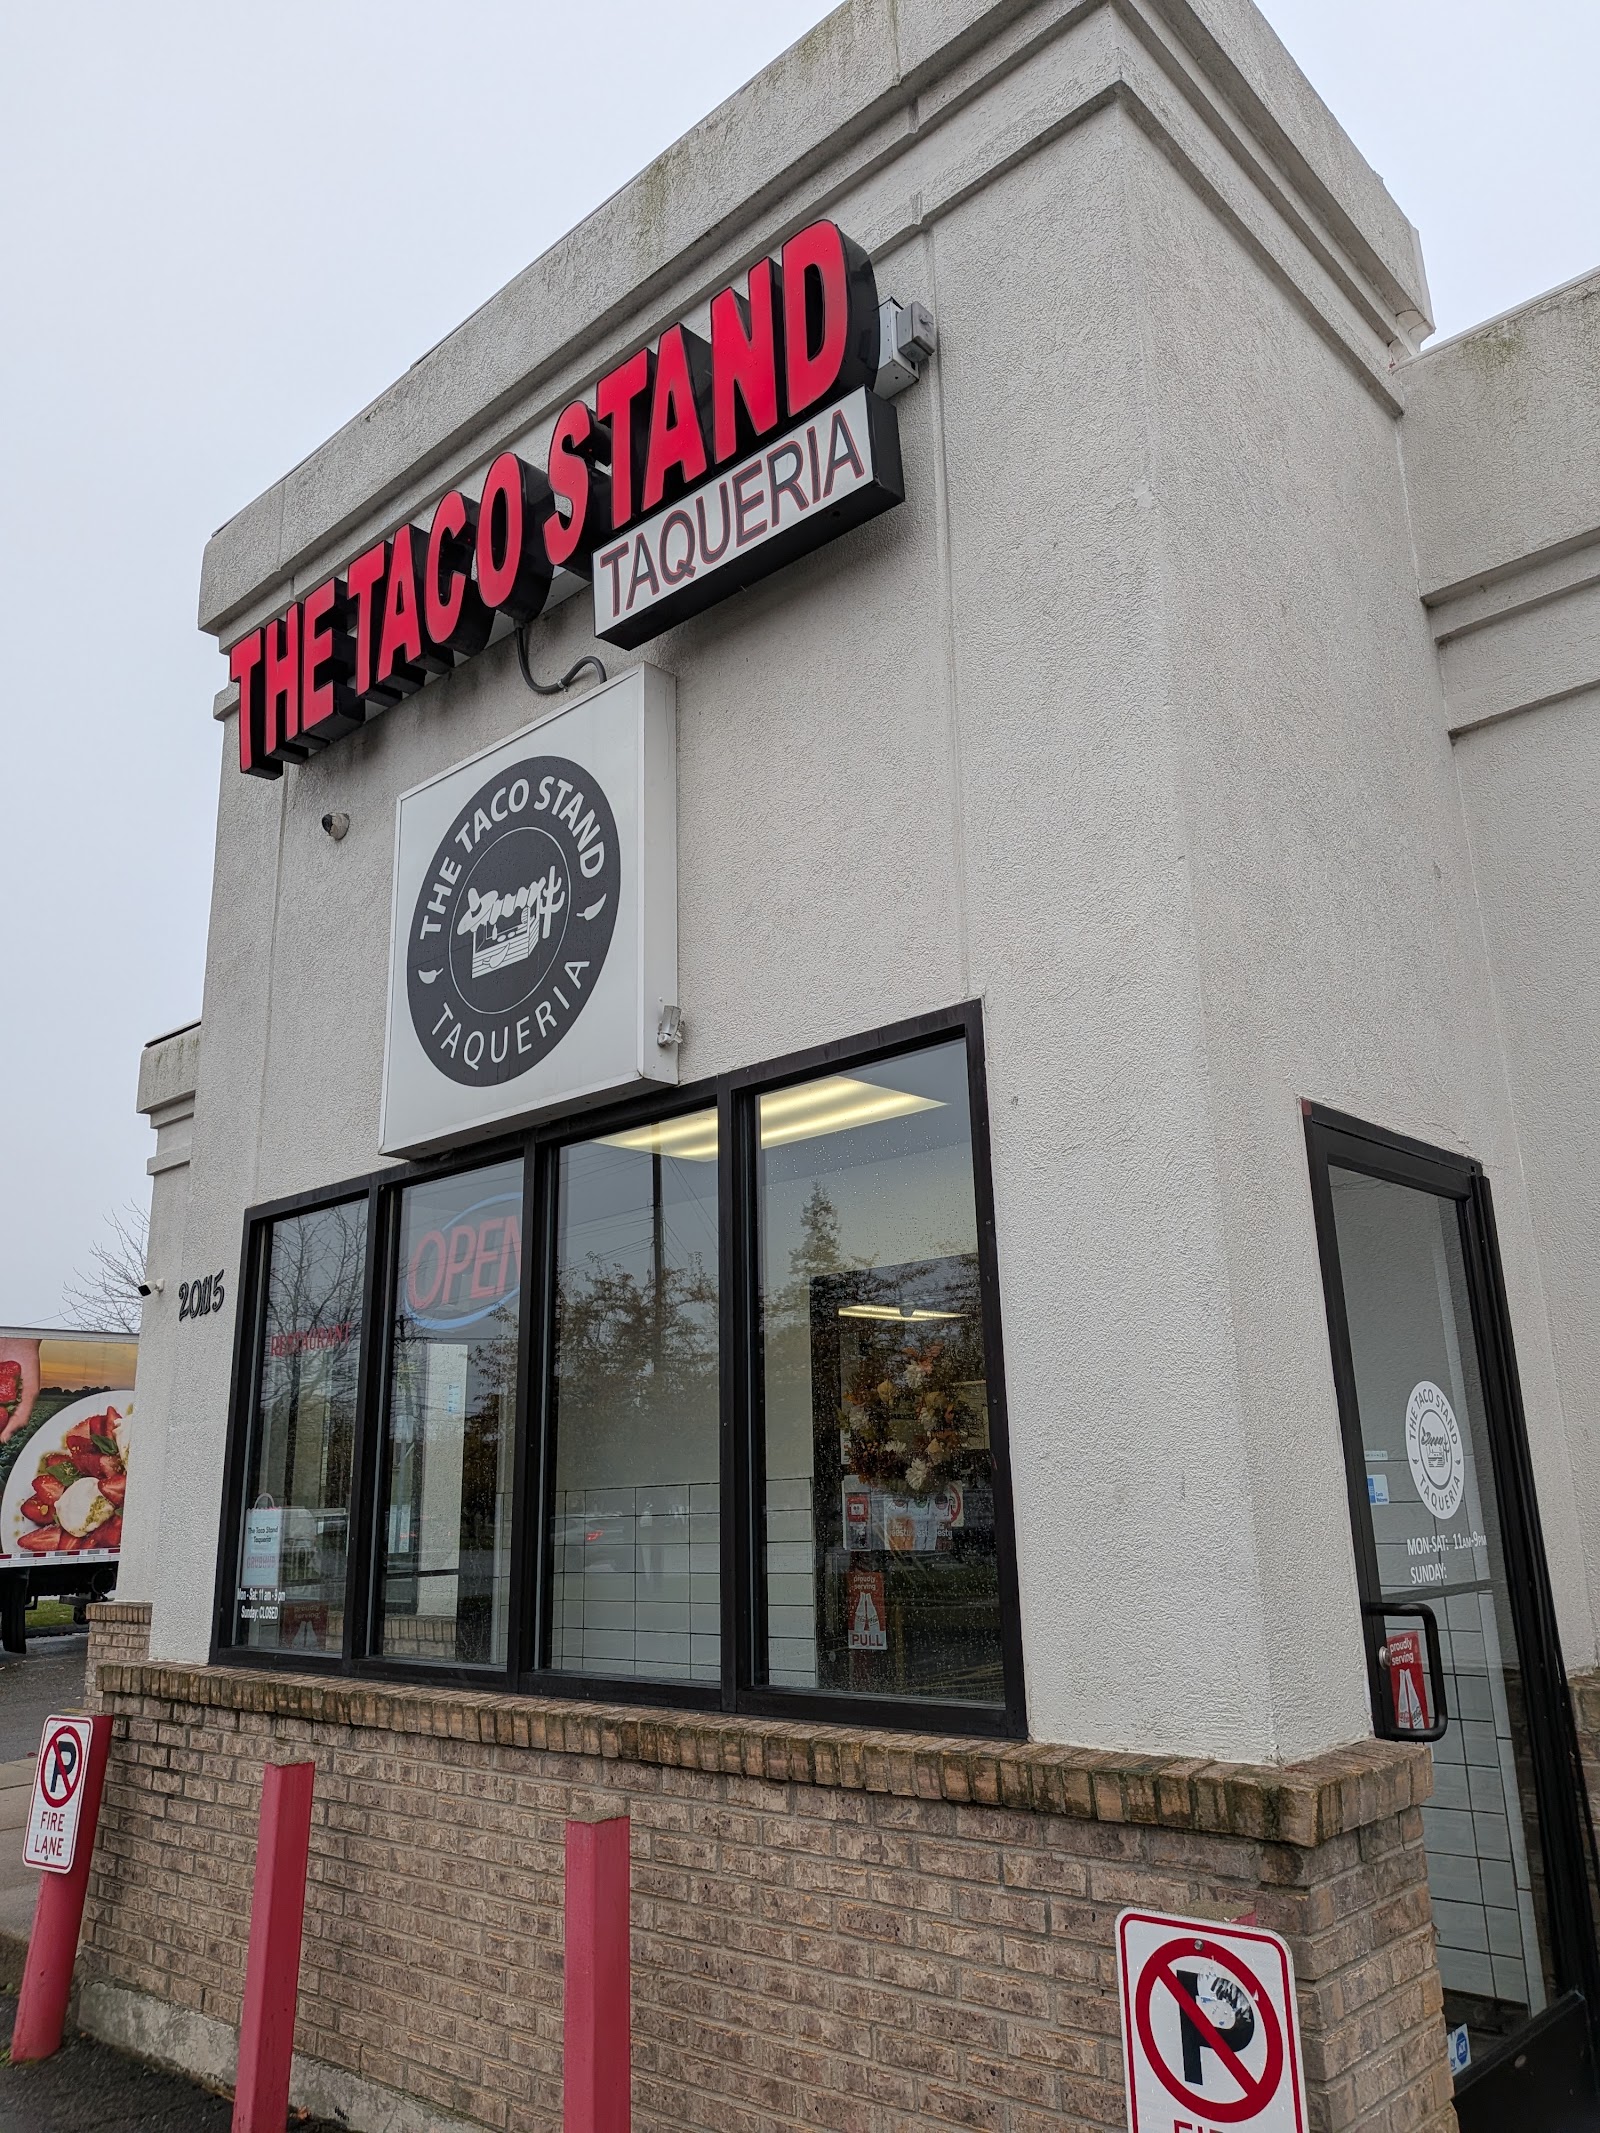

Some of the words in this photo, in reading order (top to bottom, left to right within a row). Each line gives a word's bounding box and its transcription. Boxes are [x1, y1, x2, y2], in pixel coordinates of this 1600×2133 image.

[230, 577, 337, 774] THE
[347, 452, 524, 697] TACO
[543, 219, 849, 566] STAND
[599, 408, 866, 618] TAQUERIA
[420, 856, 463, 939] THE
[454, 778, 530, 853] TACO
[533, 775, 605, 879] STAND
[431, 959, 591, 1071] TAQUERIA
[407, 1215, 521, 1310] OPEN
[271, 1321, 352, 1356] RESTAURANT
[1409, 1407, 1418, 1440] THE
[1414, 1389, 1434, 1410] TACO
[1436, 1394, 1458, 1445] STAND
[1420, 1474, 1461, 1511] TAQUERIA
[1406, 1534, 1449, 1556] MON-SAT:
[1410, 1563, 1447, 1585] SUNDAY:
[259, 1605, 279, 1620] CLOSED
[851, 1633, 884, 1647] PULL
[1390, 1638, 1412, 1654] proudly
[1392, 1652, 1414, 1666] serving
[49, 1741, 77, 1793] P
[40, 1810, 65, 1833] FIRE
[34, 1834, 65, 1857] LANE
